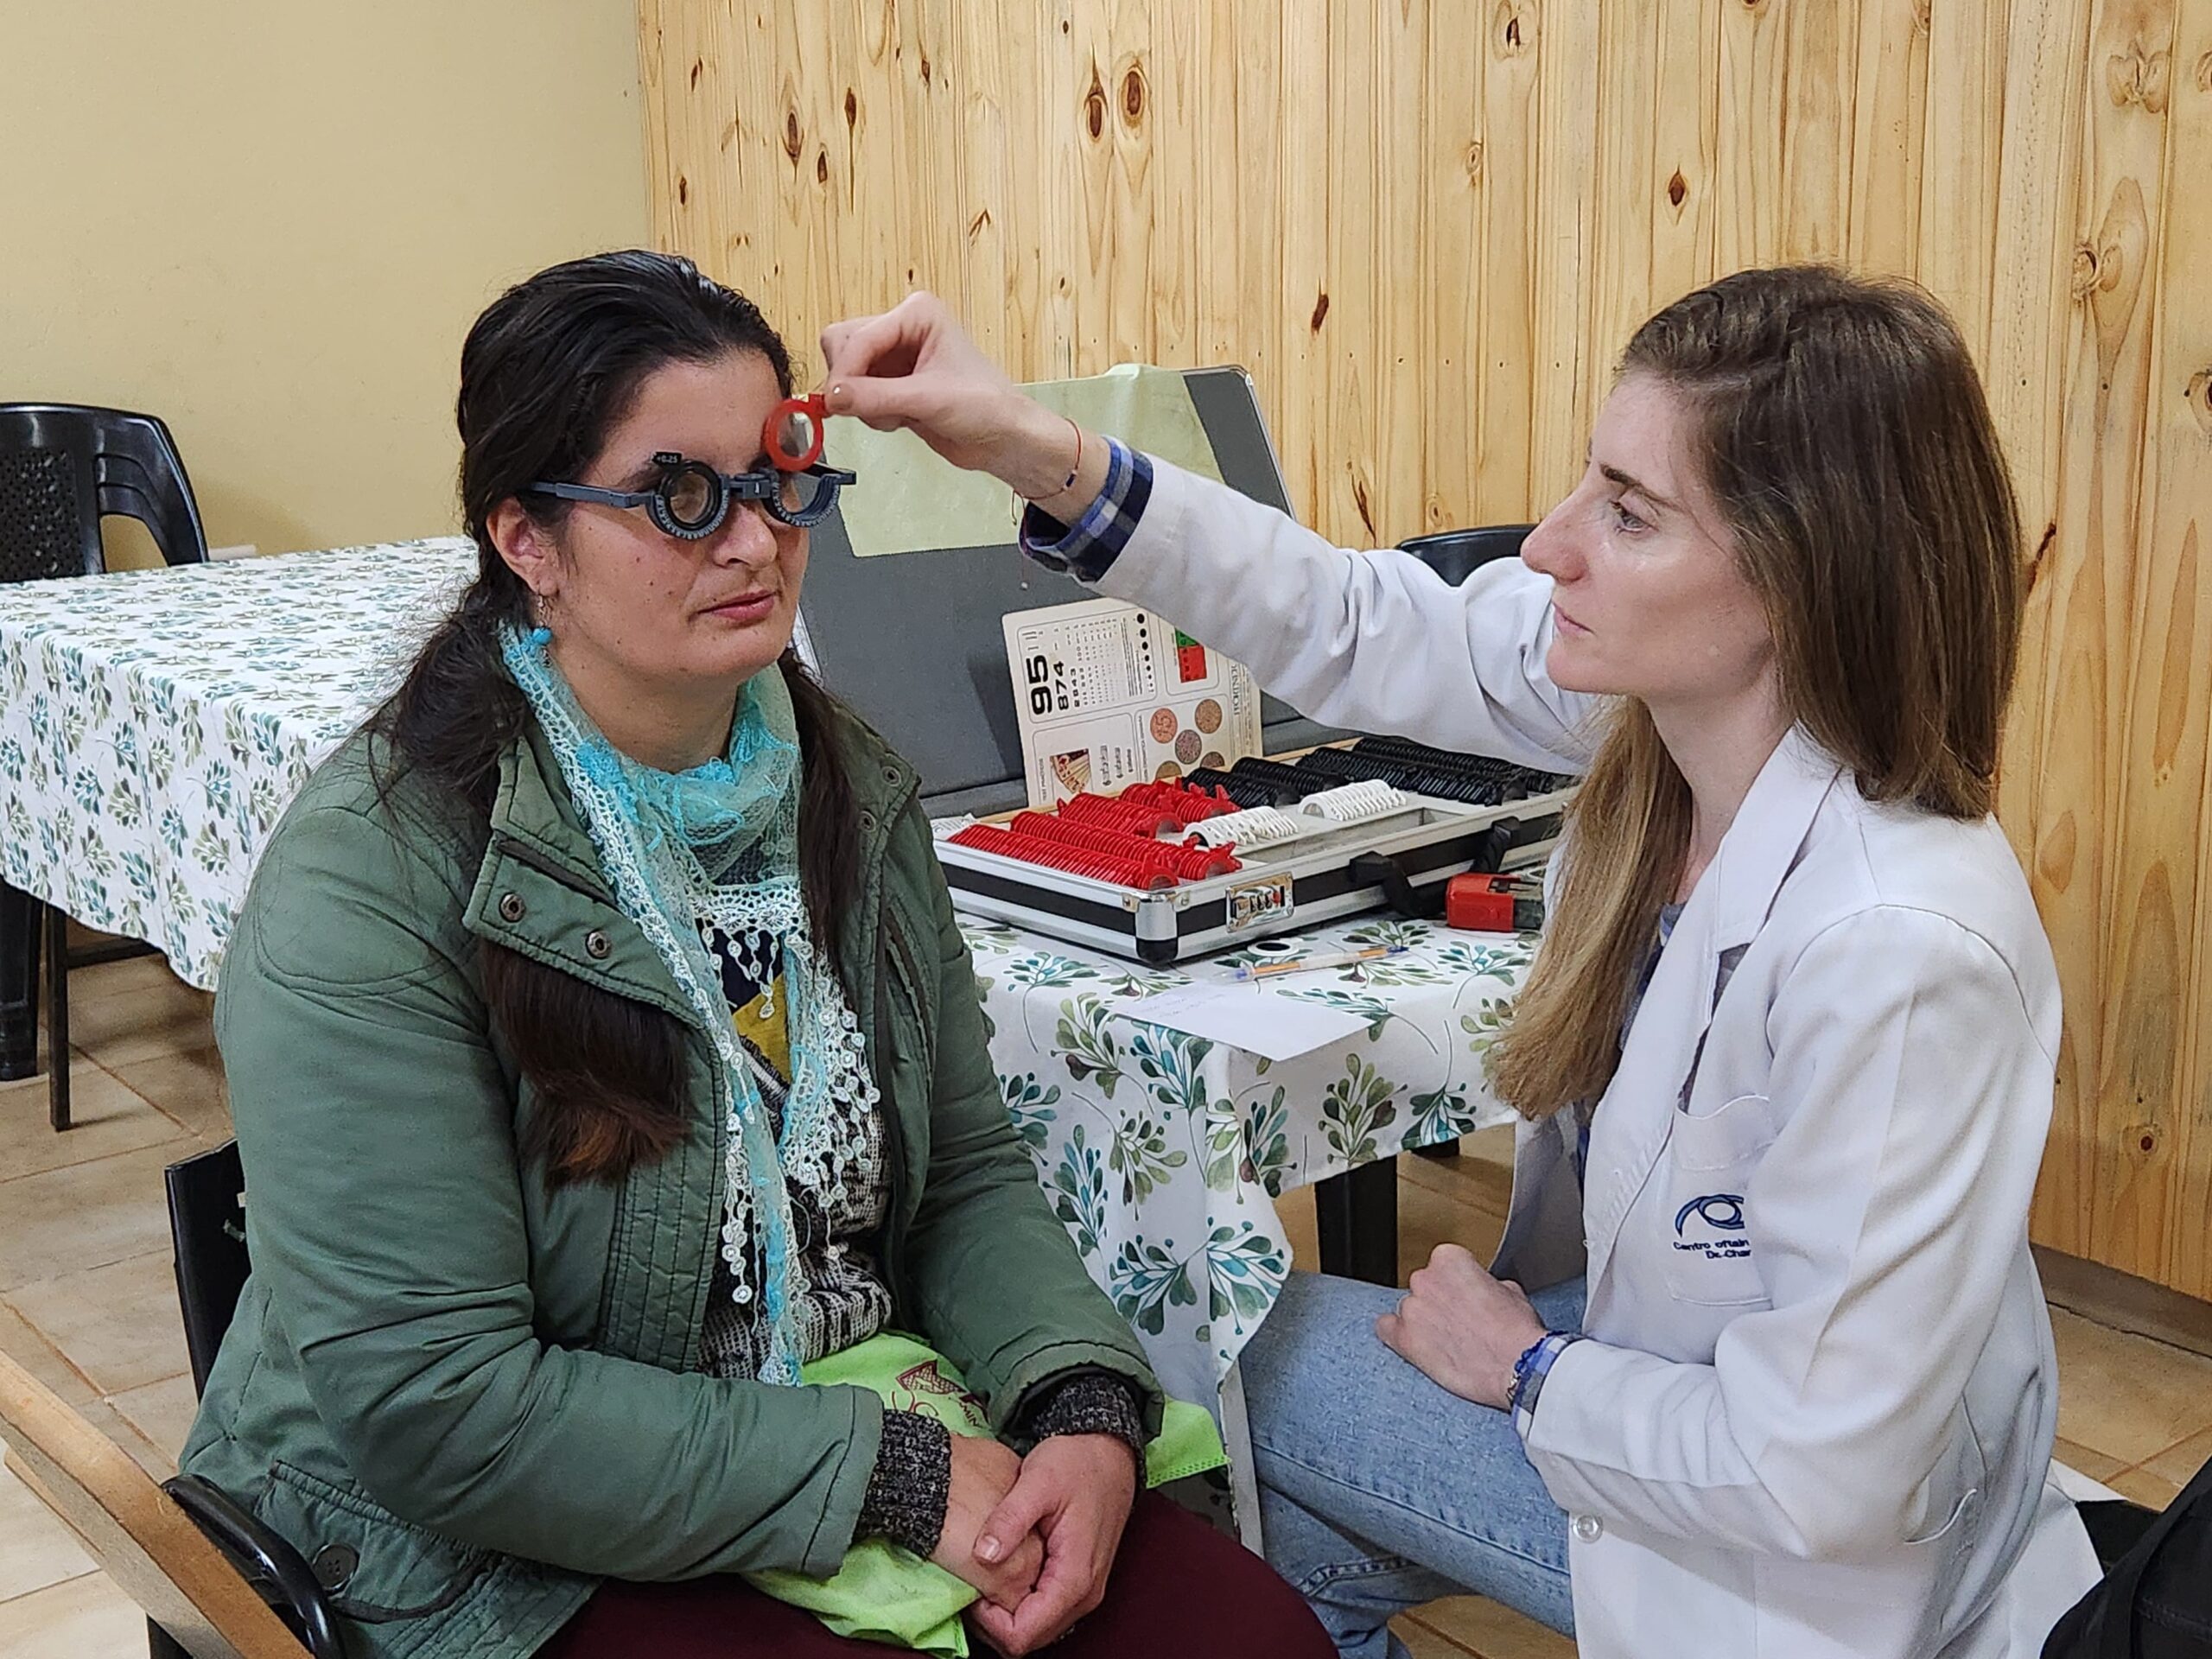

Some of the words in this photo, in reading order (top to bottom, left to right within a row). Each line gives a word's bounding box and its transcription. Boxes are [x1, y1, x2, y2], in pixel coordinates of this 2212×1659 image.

[1026, 655, 1052, 715] 95
[1053, 660, 1069, 711] 874
[1673, 1242, 1711, 1251] Centro
